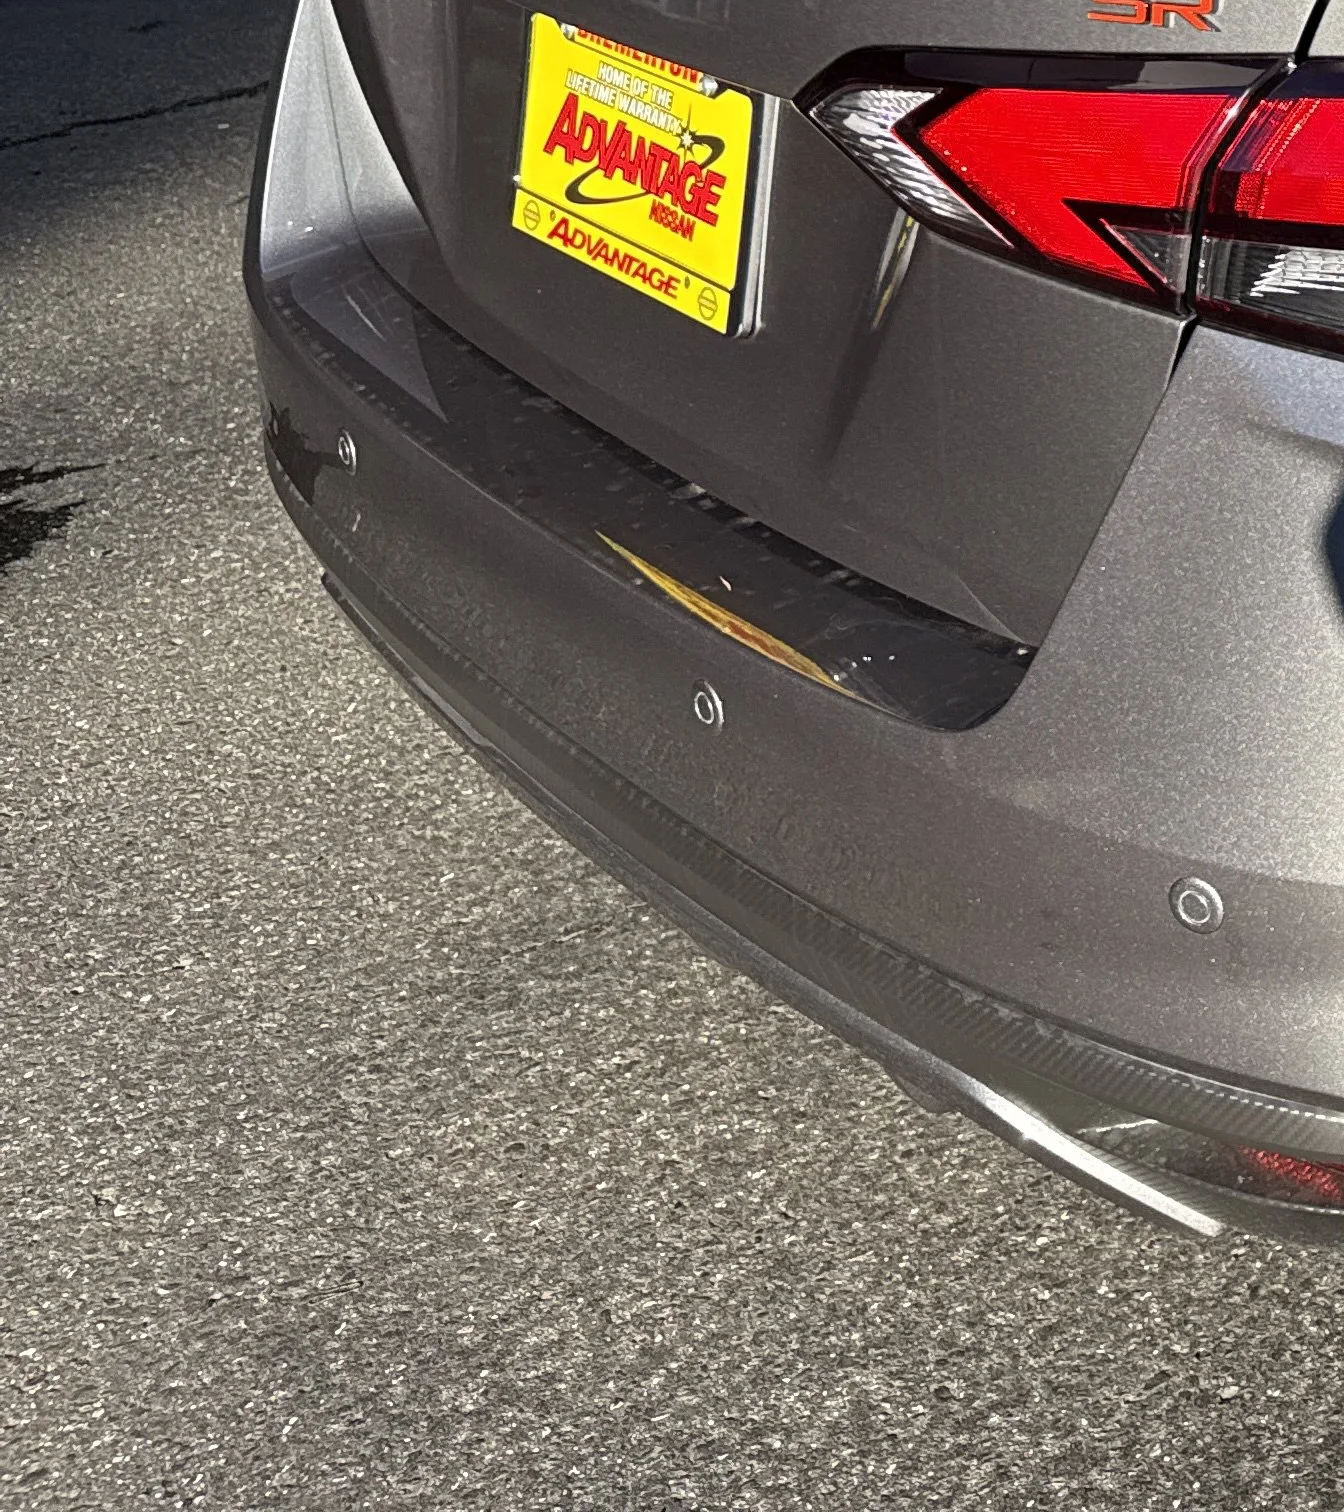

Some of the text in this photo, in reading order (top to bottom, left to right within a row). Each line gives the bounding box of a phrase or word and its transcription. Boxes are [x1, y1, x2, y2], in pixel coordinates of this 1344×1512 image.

[565, 68, 617, 108] LIFETIME
[598, 60, 674, 111] HOME OF THE
[543, 93, 727, 227] ADVANTAGE
[649, 199, 697, 242] NISSAN
[547, 217, 681, 300] ADVANTAGE
